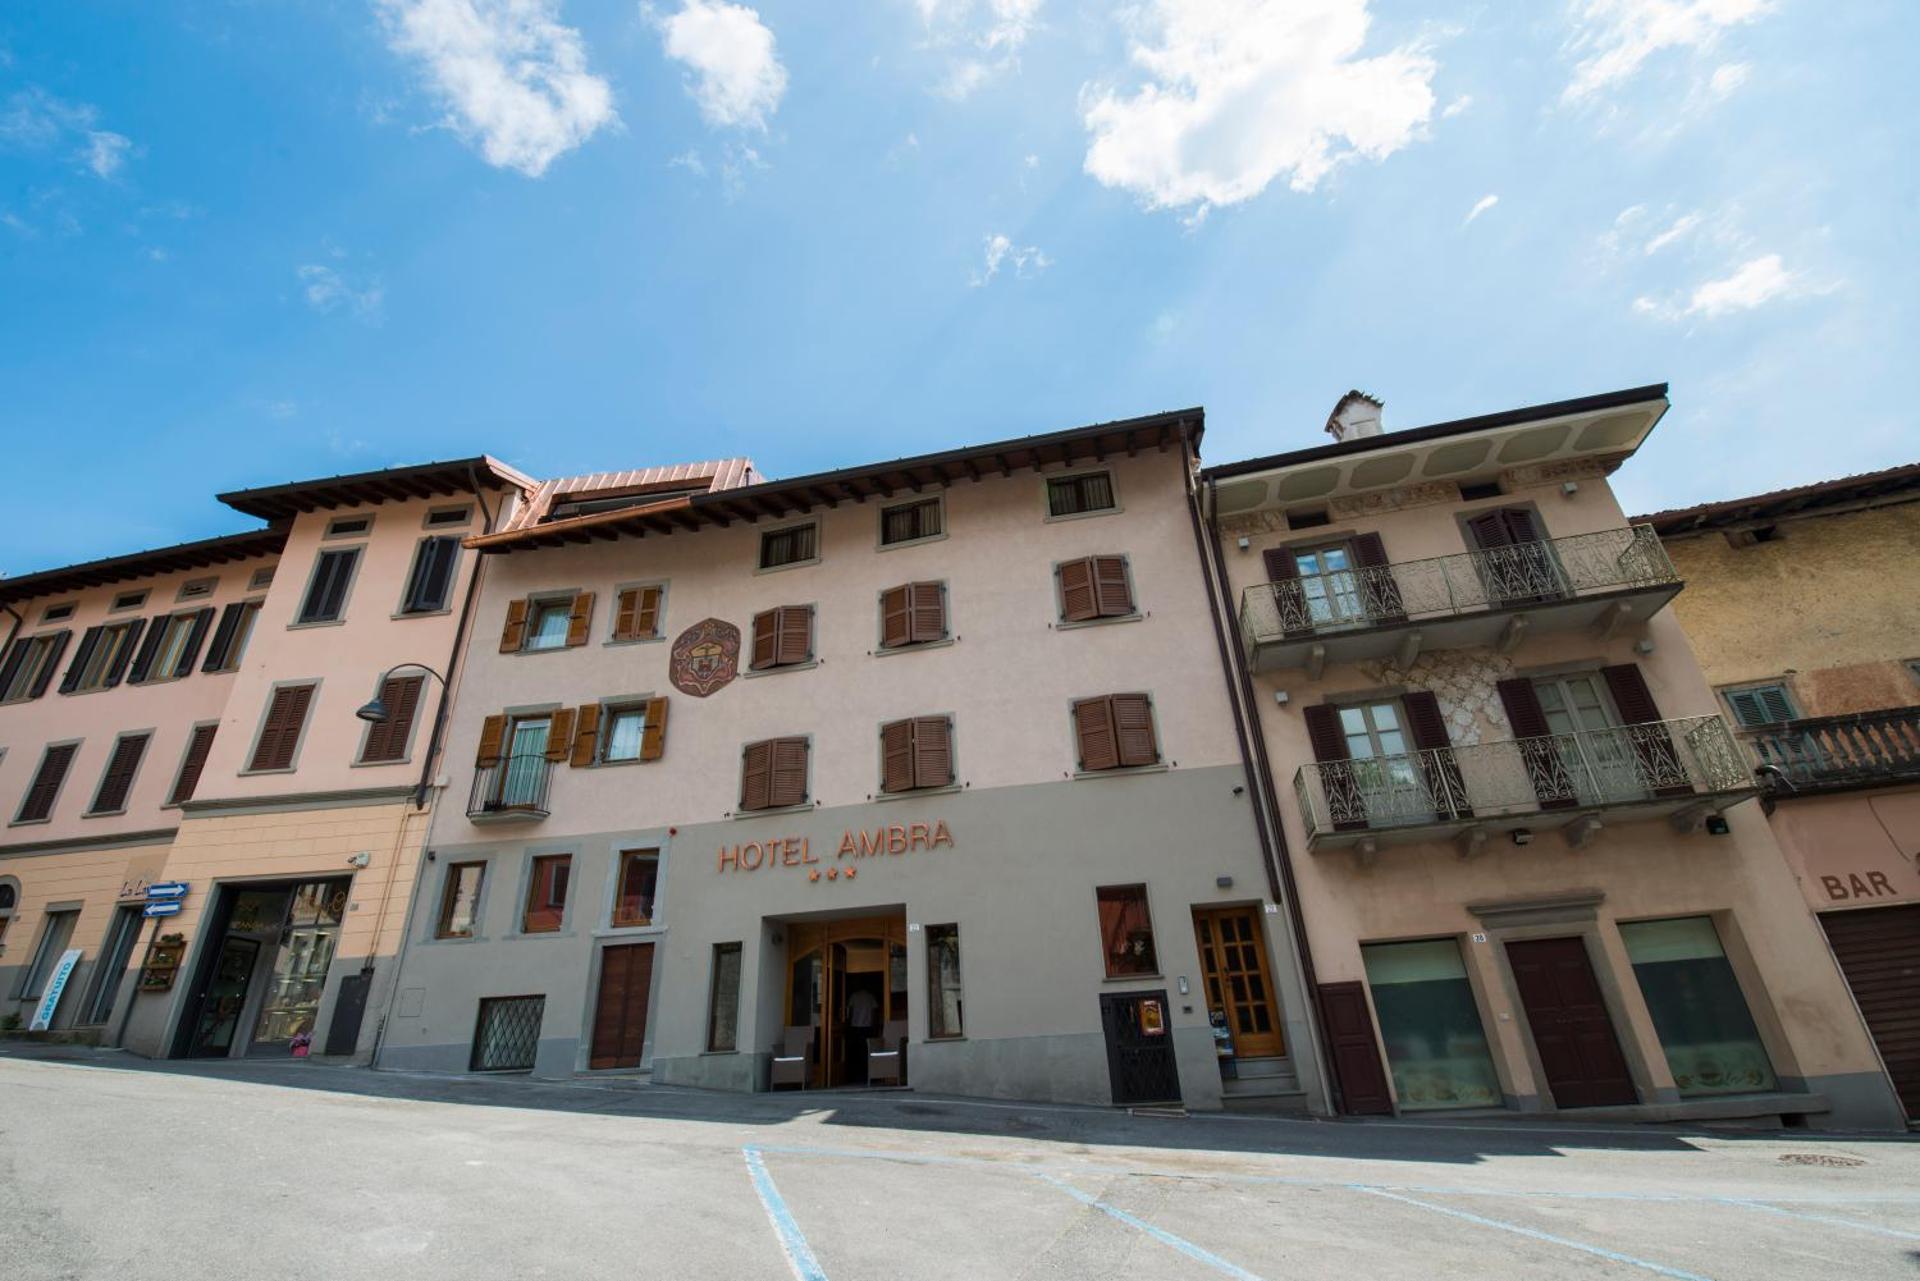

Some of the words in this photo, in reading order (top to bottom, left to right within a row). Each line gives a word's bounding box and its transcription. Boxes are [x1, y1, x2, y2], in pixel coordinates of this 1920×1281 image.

[719, 838, 818, 873] HOTEL
[837, 819, 953, 859] AMBRA
[1820, 871, 1898, 900] BAR
[41, 962, 72, 1020] GRATUITO
